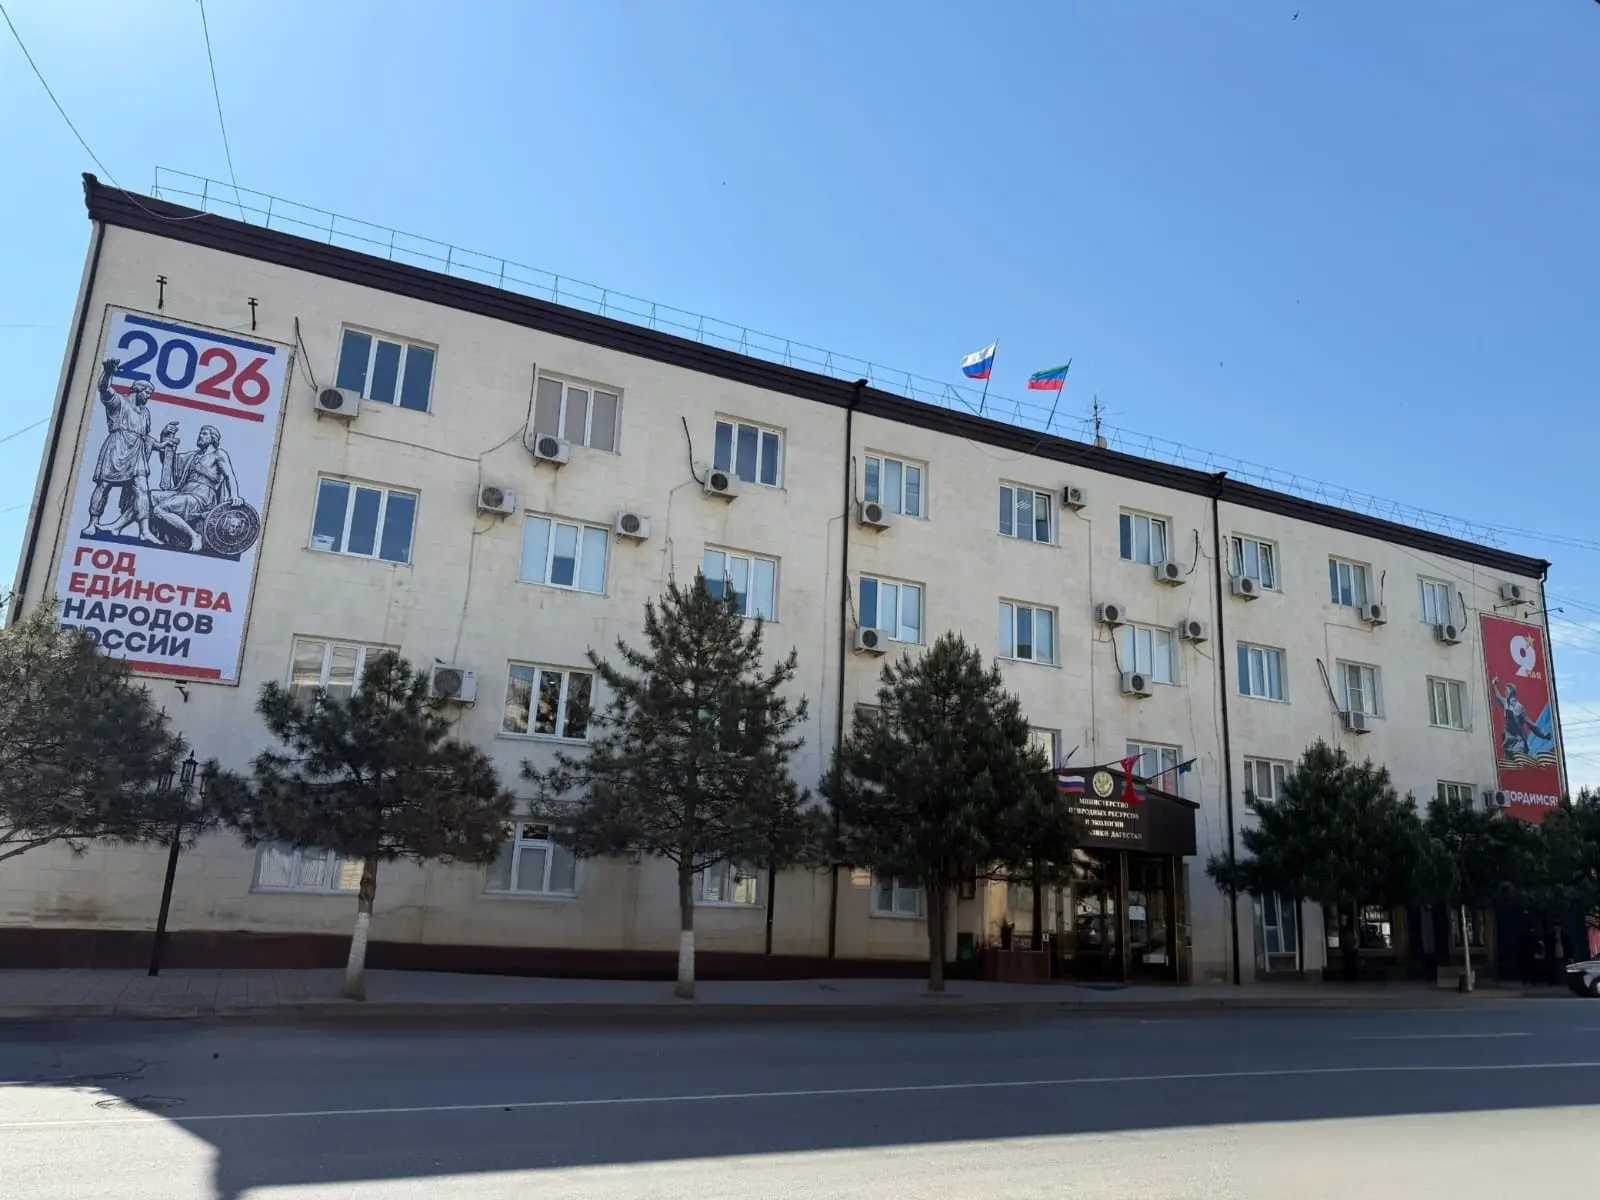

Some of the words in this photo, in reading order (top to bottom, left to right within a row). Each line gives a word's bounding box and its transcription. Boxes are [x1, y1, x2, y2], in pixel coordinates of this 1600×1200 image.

[114, 330, 270, 406] 2026
[73, 546, 136, 577] ГОД
[68, 572, 232, 613] ЕДИНСТВА
[62, 598, 214, 635] НАРОДОВ
[1509, 635, 1537, 678] 9
[1079, 798, 1129, 809] МИНИСТЕРСТВО
[1108, 810, 1139, 819] РЕСУРСОВ
[1092, 819, 1124, 828] ЭКОЛОГИИ
